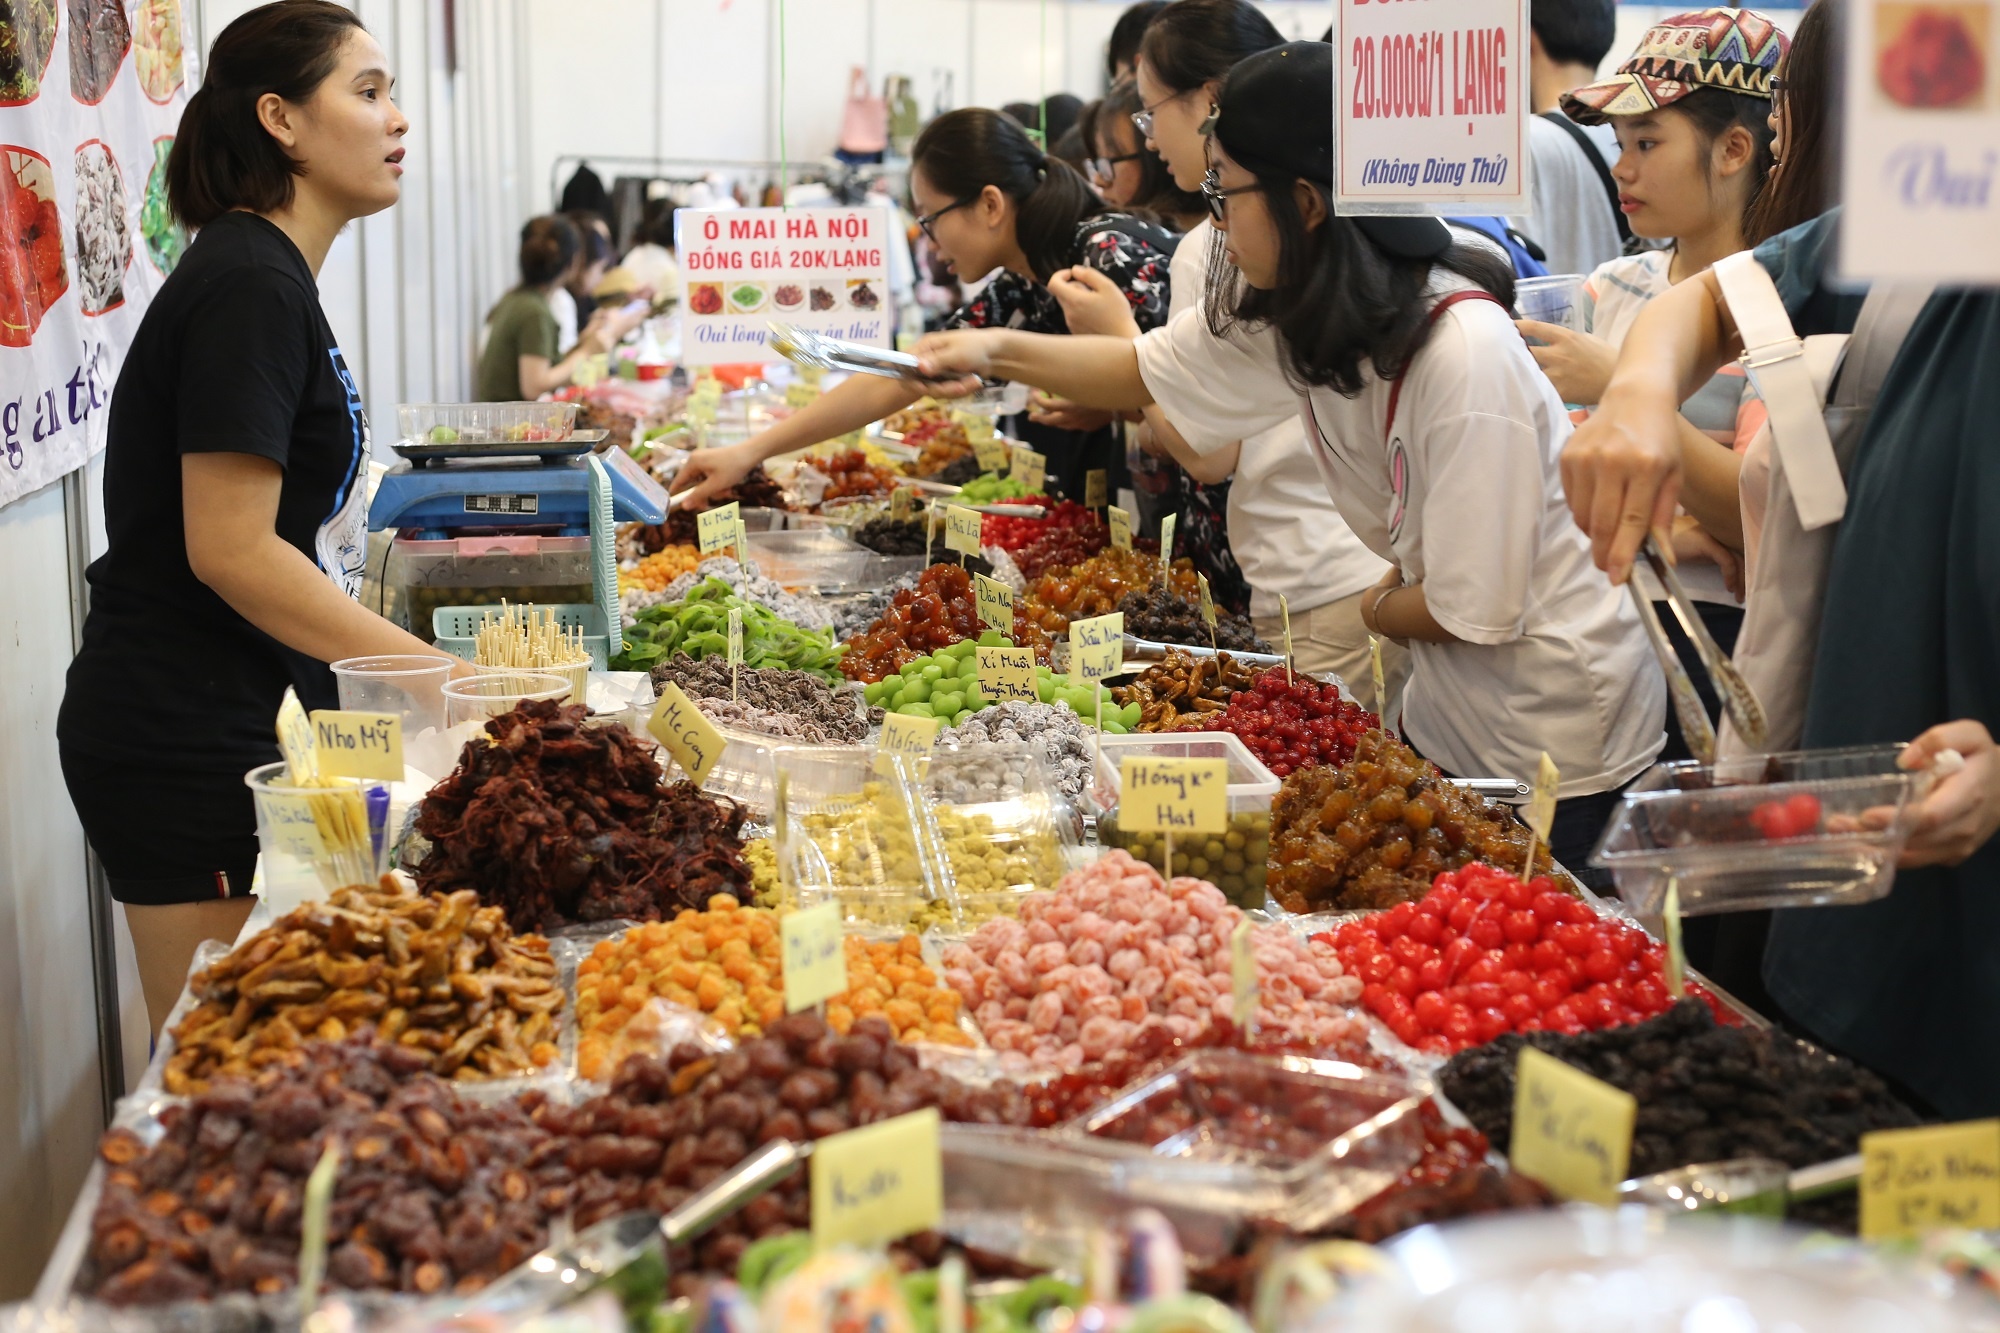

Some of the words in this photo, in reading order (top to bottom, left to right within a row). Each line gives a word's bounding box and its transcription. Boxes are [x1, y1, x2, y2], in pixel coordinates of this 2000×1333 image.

[1353, 31, 1443, 119] 20.000đ/1
[1453, 26, 1506, 136] LẠNG
[1361, 158, 1420, 187] (Không
[1422, 157, 1466, 187] Dùng
[1470, 153, 1508, 186] Thử)
[704, 215, 719, 240] Ô
[730, 220, 775, 239] MAI
[787, 213, 819, 239] HÀ
[828, 213, 868, 243] NỘI
[751, 247, 782, 269] GIÁ
[790, 249, 881, 272] 20K/LẠNG
[981, 650, 996, 669] Xí
[1000, 654, 1031, 672] Muội
[318, 721, 356, 749] Nho
[360, 719, 394, 753] Mỹ
